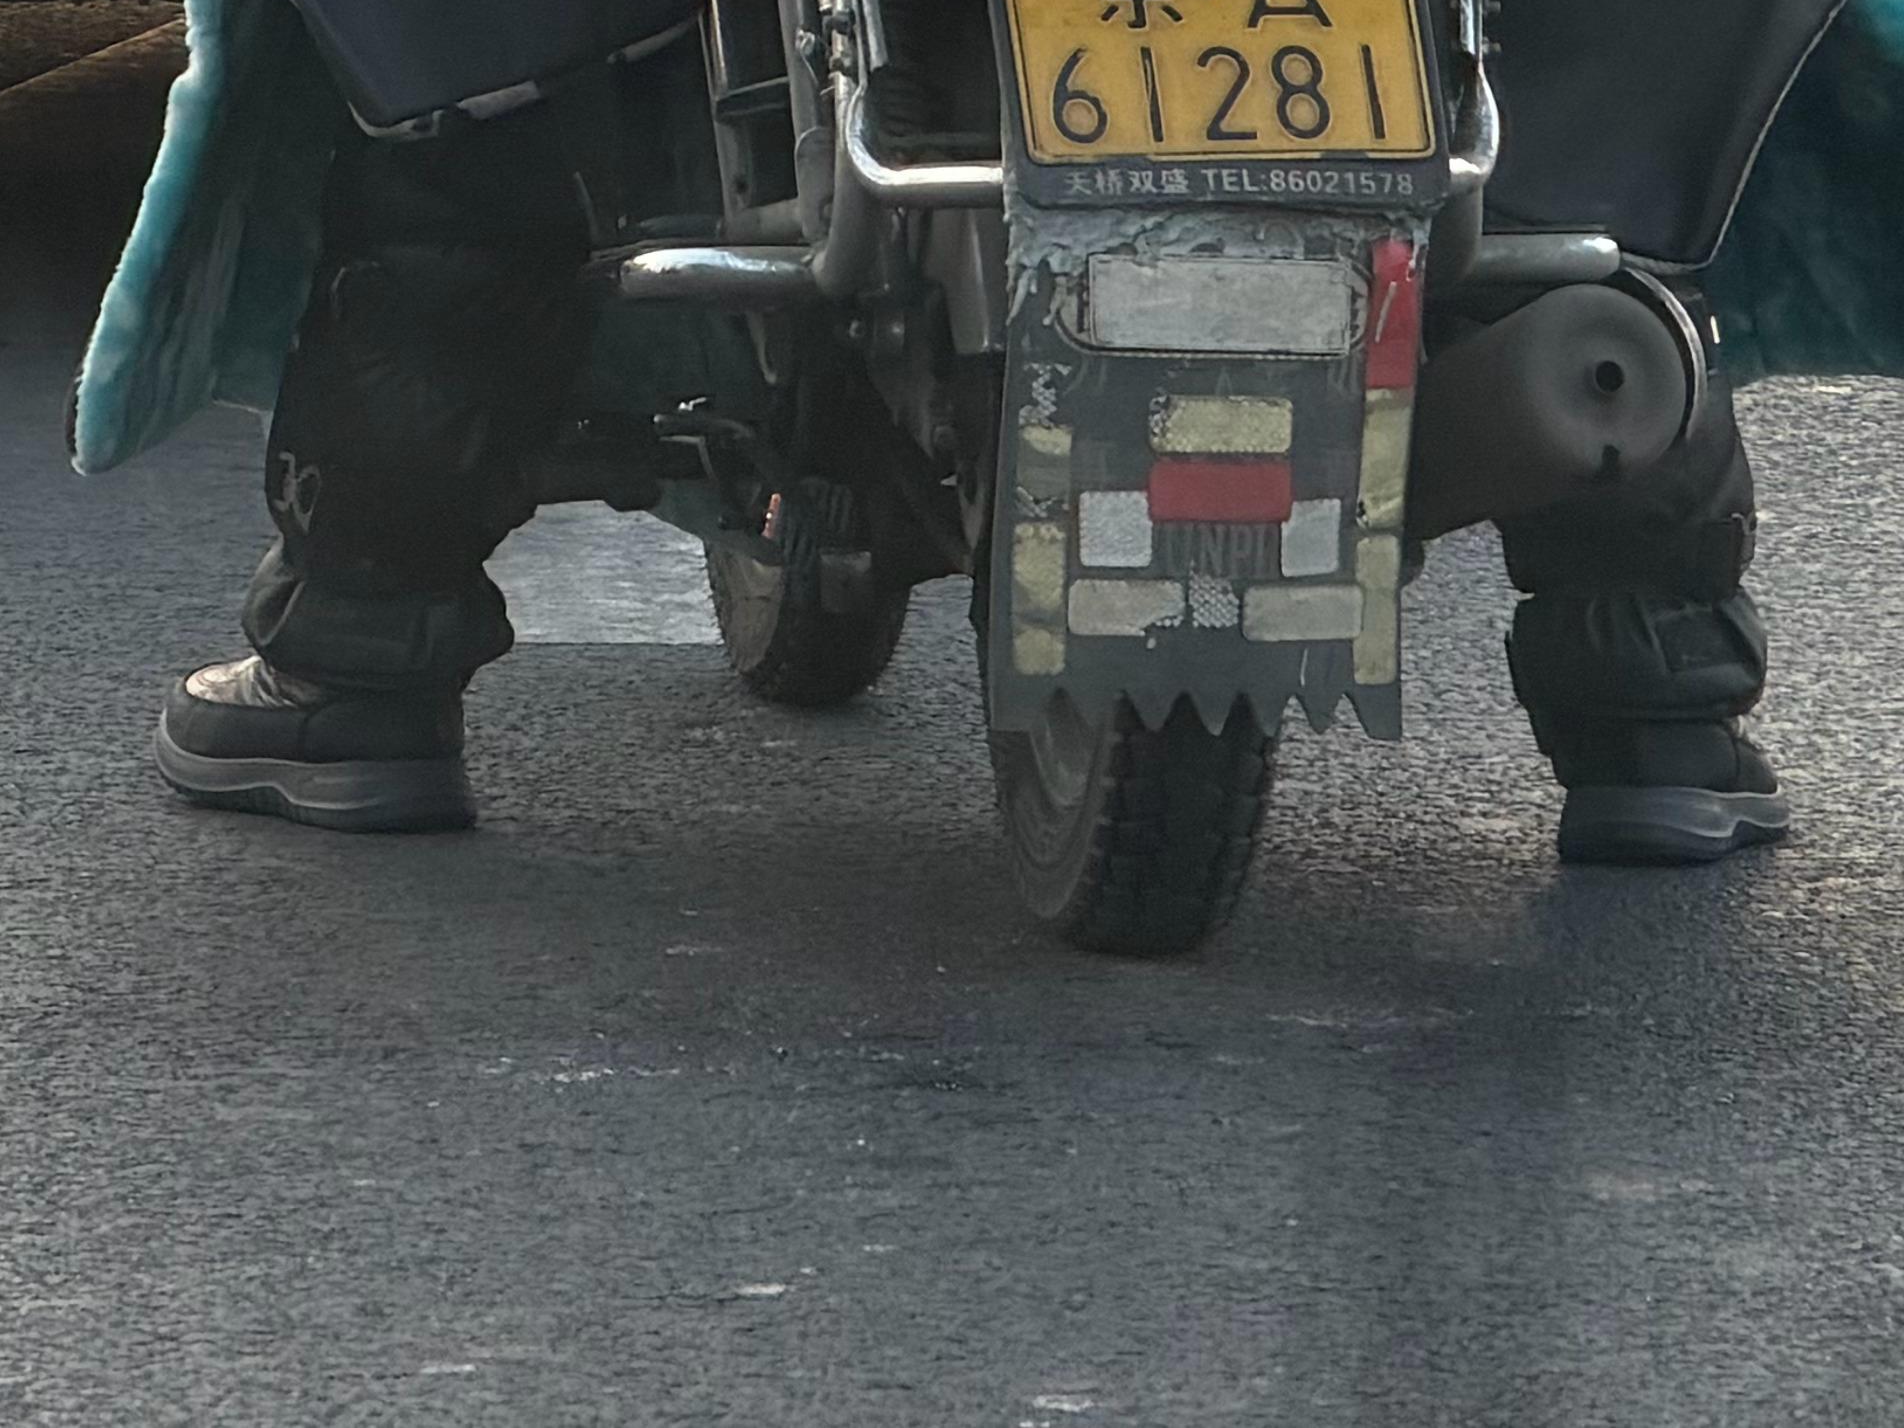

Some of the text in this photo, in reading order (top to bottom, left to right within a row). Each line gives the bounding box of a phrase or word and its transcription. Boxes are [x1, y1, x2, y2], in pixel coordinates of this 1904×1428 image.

[1052, 44, 1388, 145] 61281
[1064, 168, 1414, 196] 天桥双盛 TEL:86021578
